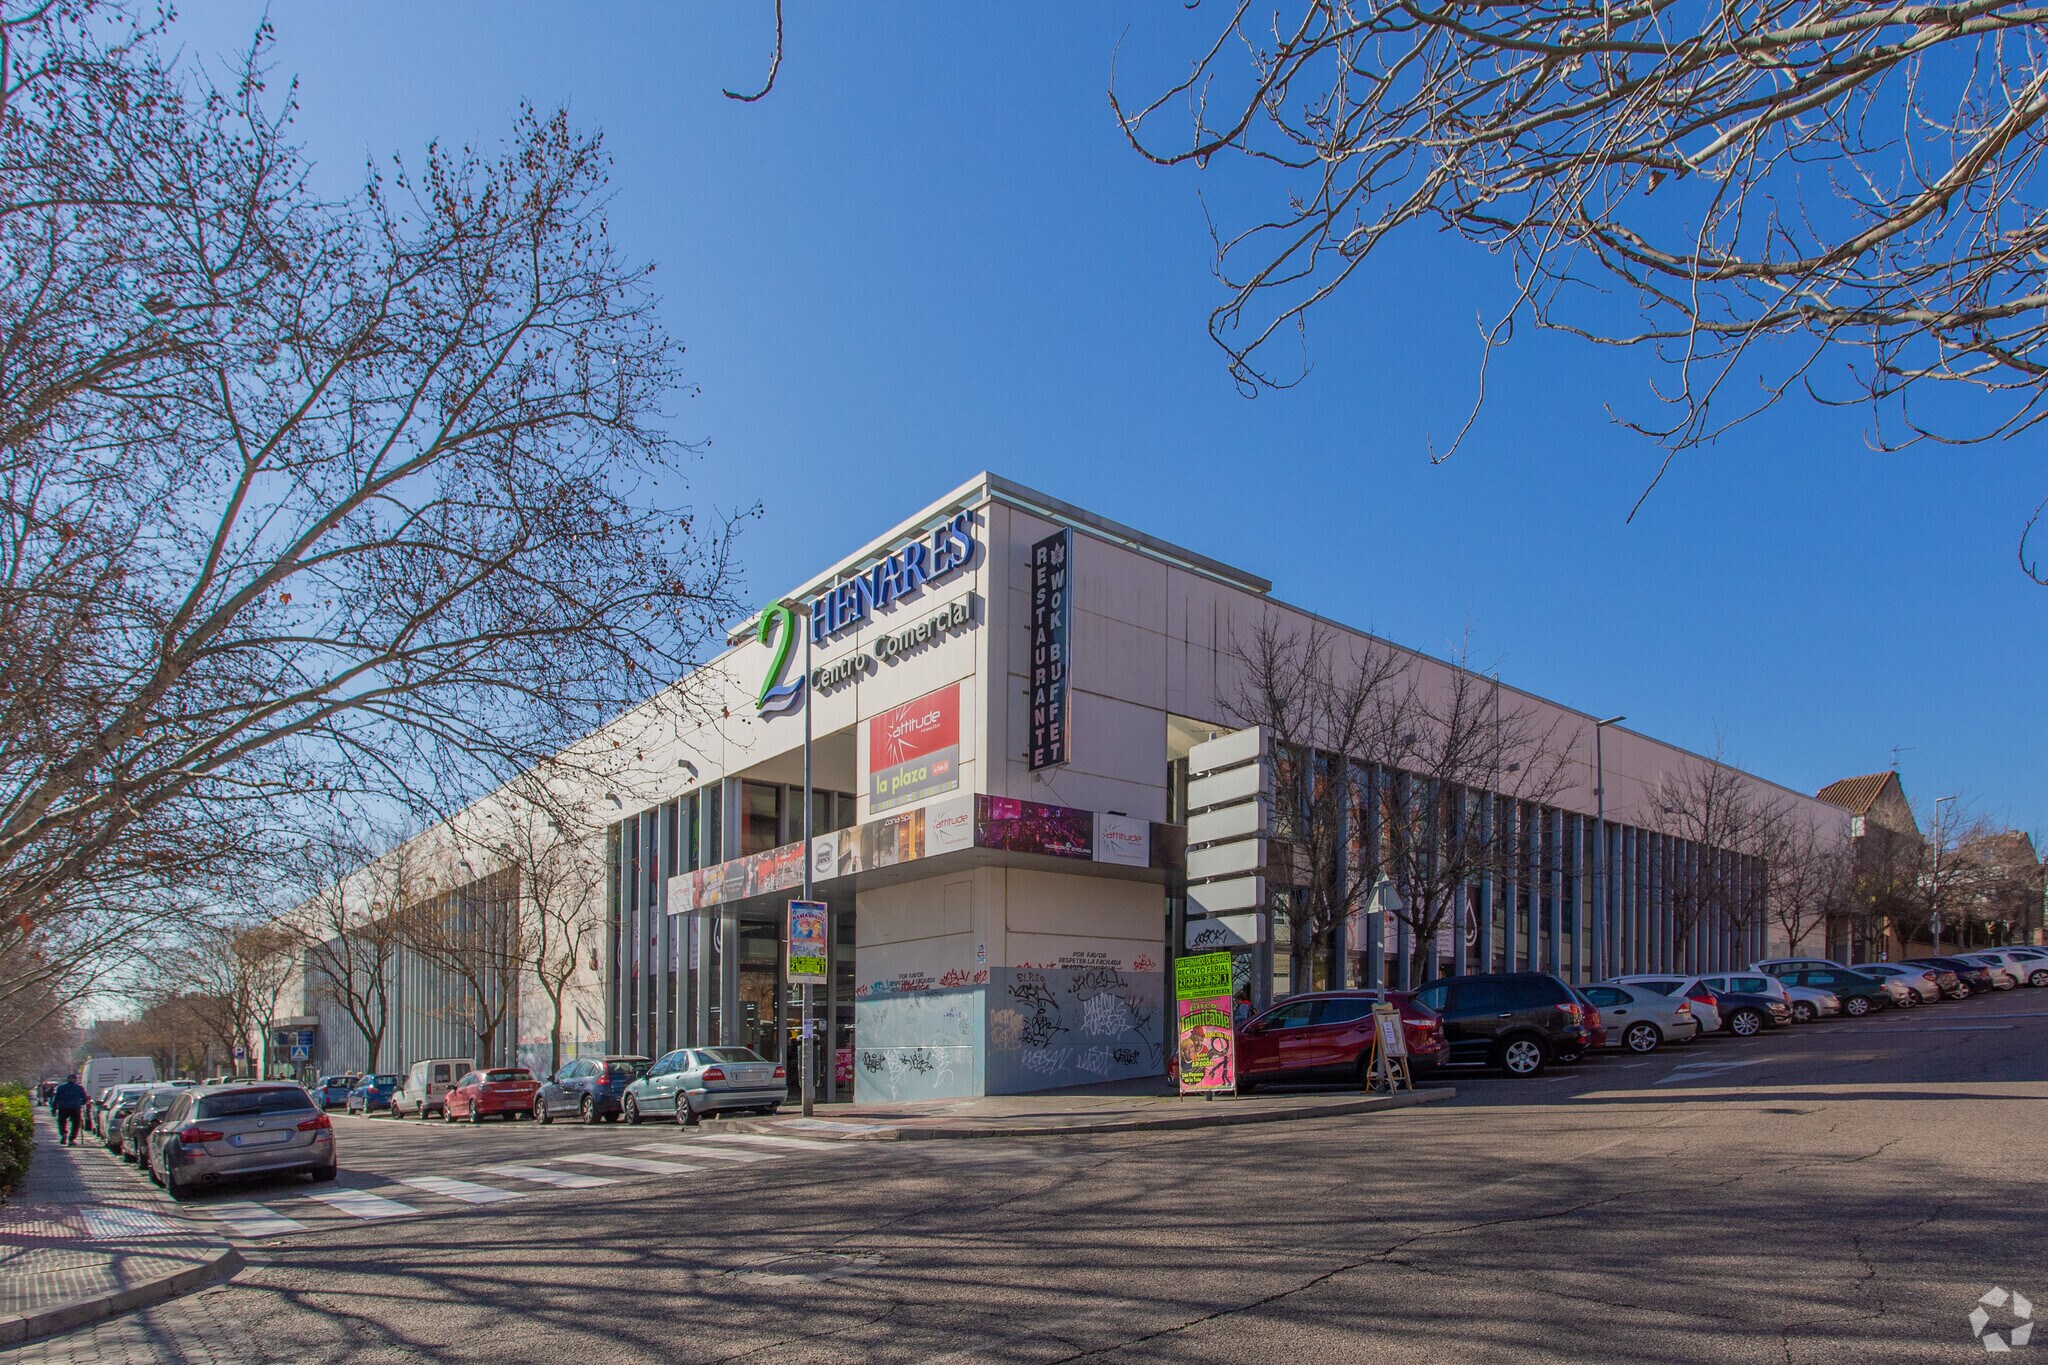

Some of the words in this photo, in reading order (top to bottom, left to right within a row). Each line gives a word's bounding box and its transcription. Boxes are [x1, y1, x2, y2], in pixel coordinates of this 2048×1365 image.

[811, 510, 974, 645] HENARES
[1050, 569, 1064, 630] WOK
[811, 653, 869, 692] Centro
[873, 591, 974, 663] Comercial
[1034, 547, 1047, 766] RESTAURANTE
[1049, 643, 1062, 760] BUFFET
[892, 710, 941, 738] attitude
[876, 775, 888, 794] la
[891, 766, 927, 795] plaza
[935, 814, 968, 829] attitude
[1105, 832, 1142, 843] attitude
[1177, 967, 1206, 976] RECINTO
[1206, 964, 1229, 974] FERIAL
[1181, 1009, 1230, 1034] Inimitable
